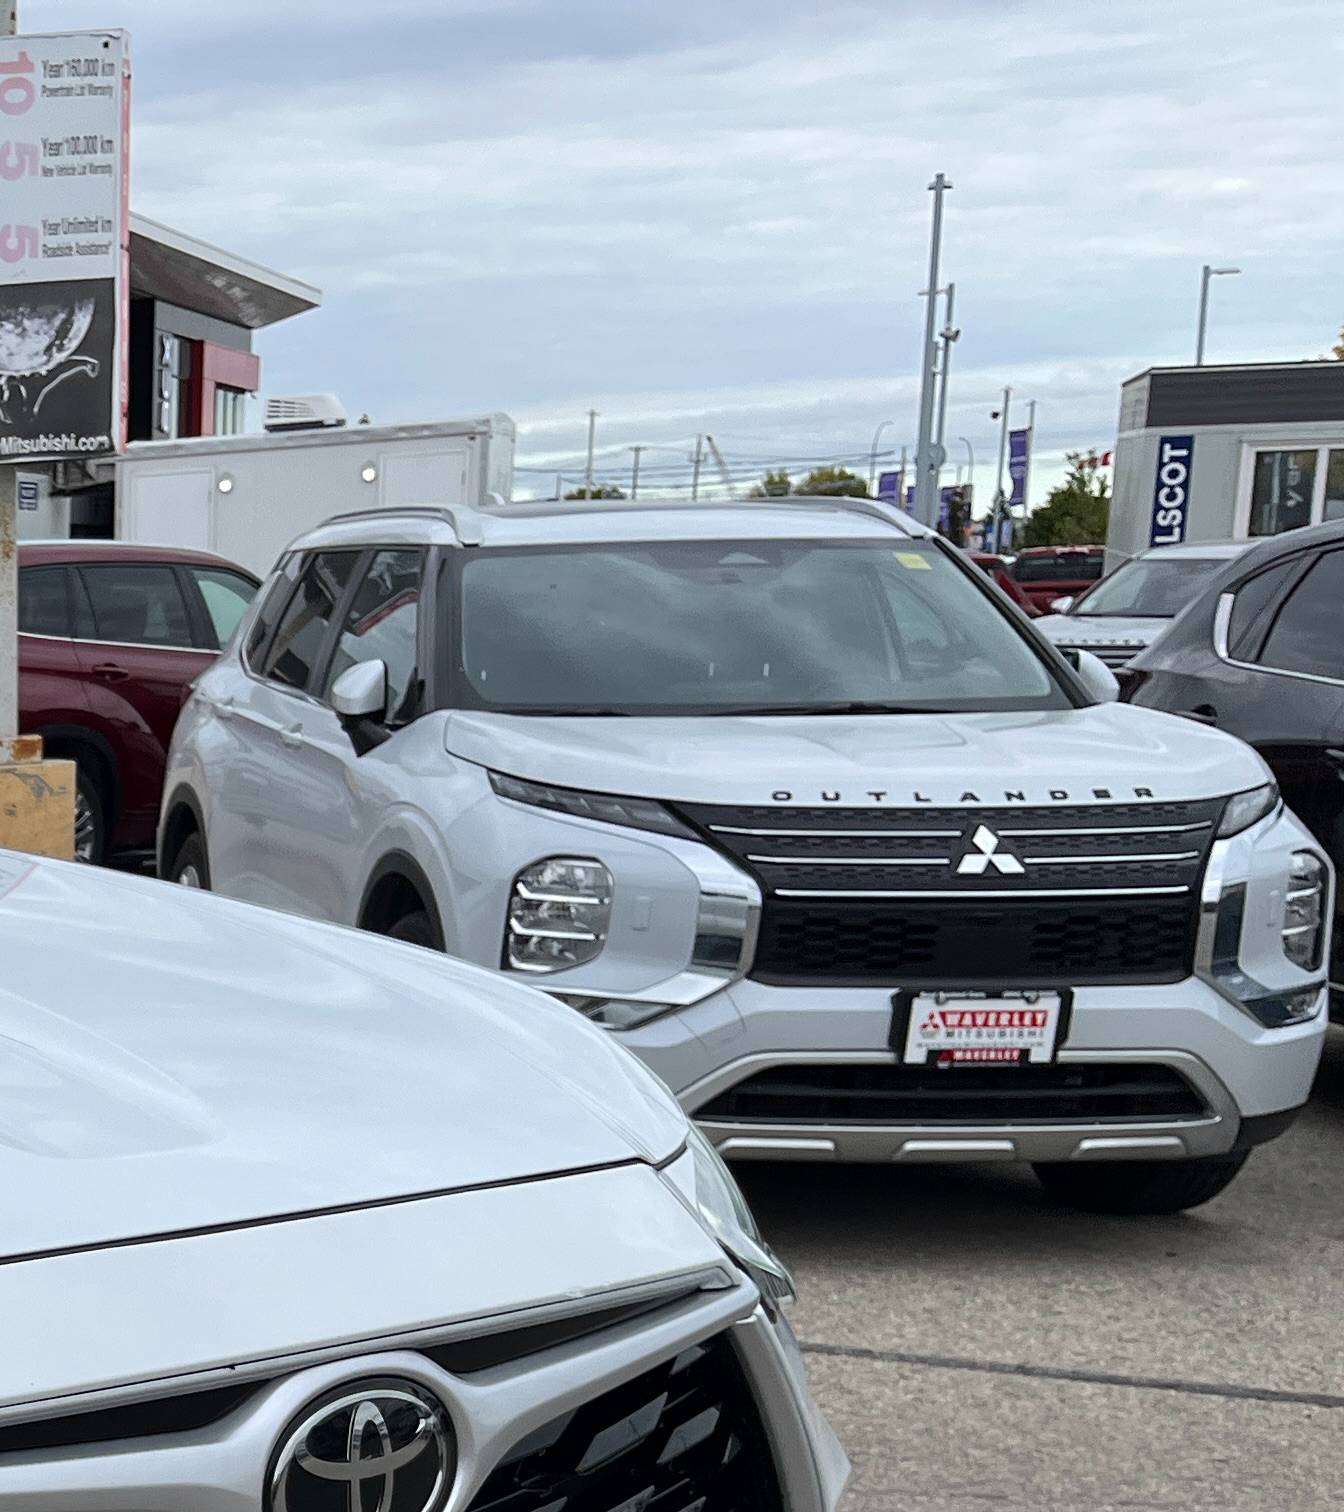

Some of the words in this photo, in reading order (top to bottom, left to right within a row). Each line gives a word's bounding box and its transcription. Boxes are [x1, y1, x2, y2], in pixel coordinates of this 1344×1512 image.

[771, 787, 1155, 802] OUTLANDER
[945, 1011, 1048, 1027] WAVERLEY
[945, 1029, 1045, 1039] MITSUBISHI
